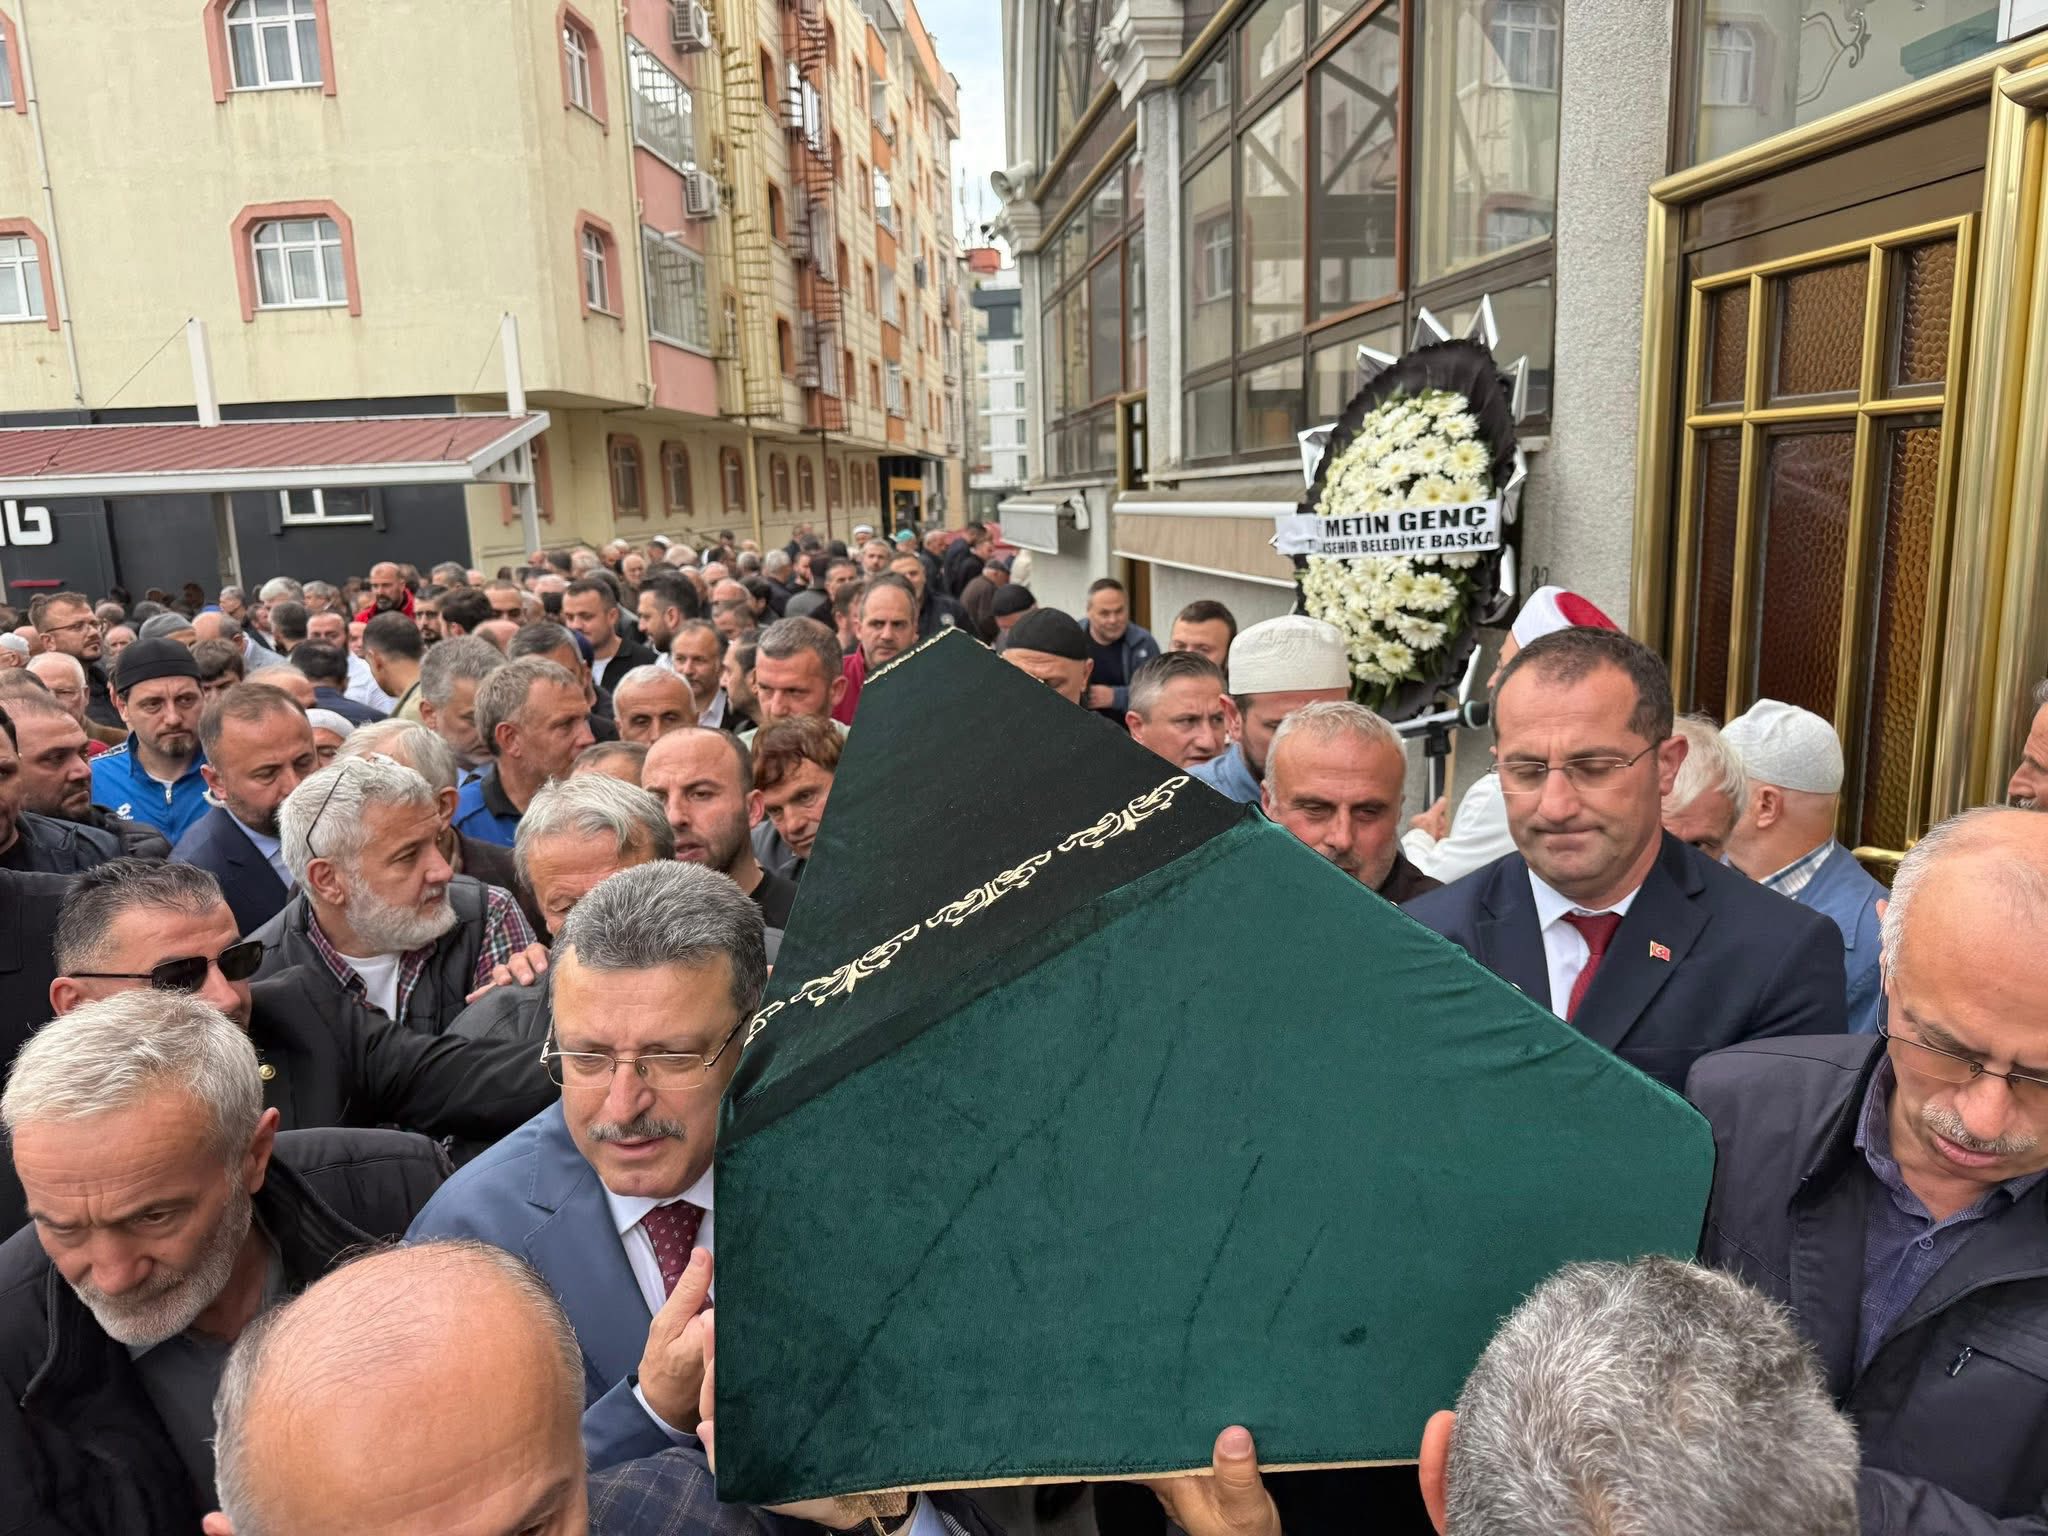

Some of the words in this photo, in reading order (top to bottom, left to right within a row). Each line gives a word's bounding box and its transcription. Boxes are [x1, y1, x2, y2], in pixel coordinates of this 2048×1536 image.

[0, 499, 53, 547] G
[1326, 513, 1389, 537] METİN
[1400, 506, 1487, 532] GENÇ
[1361, 535, 1425, 553] BELEDİYE
